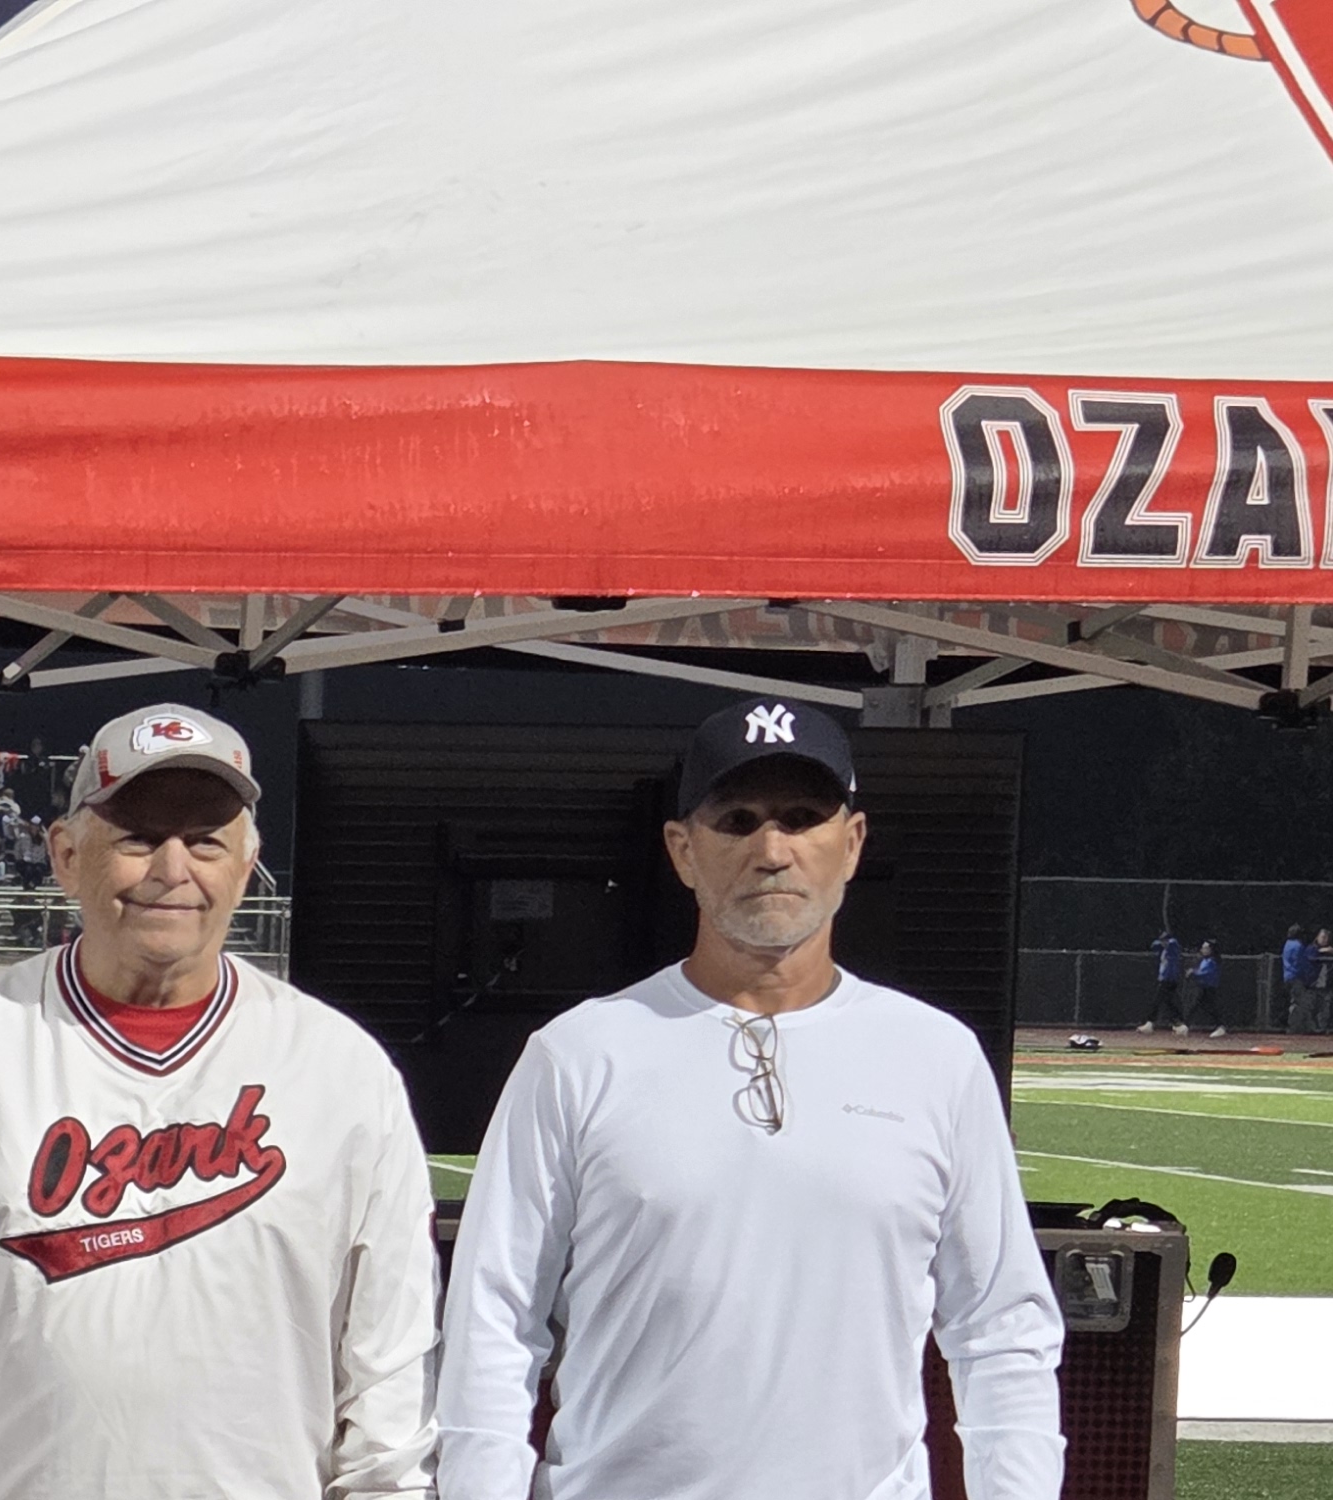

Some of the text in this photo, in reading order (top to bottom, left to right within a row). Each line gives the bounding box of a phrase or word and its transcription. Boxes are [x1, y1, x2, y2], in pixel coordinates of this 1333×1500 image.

[939, 384, 1333, 570] OZA
[745, 703, 795, 743] NY
[28, 1084, 272, 1218] Ozark
[80, 1228, 144, 1252] TIGERS
